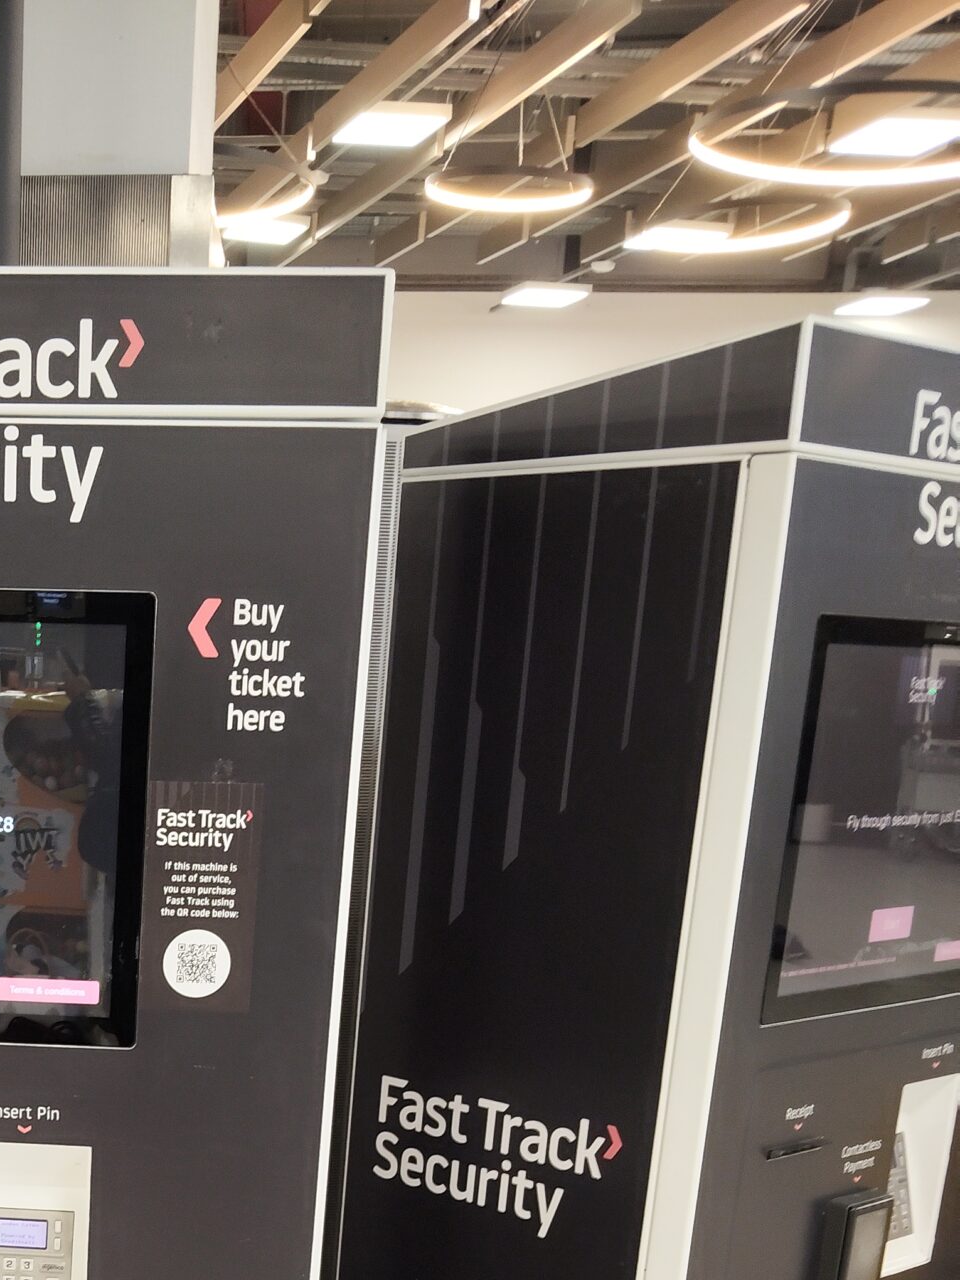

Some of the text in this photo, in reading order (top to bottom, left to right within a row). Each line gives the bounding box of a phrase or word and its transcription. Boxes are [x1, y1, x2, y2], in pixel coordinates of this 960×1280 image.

[909, 389, 960, 462] Fas
[233, 598, 285, 633] Buy
[231, 639, 291, 667] your
[228, 667, 306, 698] ticket
[226, 702, 285, 732] here
[156, 808, 247, 830] Fast Track
[156, 827, 234, 852] Security
[164, 861, 238, 872] If this machine is
[171, 873, 232, 885] out of service,
[163, 886, 237, 896] you can purchase
[166, 896, 235, 909] Fast Track using
[161, 907, 239, 919] the QR code below:
[36, 1105, 60, 1121] Pin
[785, 1104, 815, 1120] Receipt
[378, 1075, 606, 1180] Fast Track
[841, 1139, 882, 1159] Contactless
[843, 1156, 875, 1175] Payment
[372, 1131, 564, 1239] Security
[6, 1260, 13, 1268] 2
[24, 1261, 30, 1269] 3
